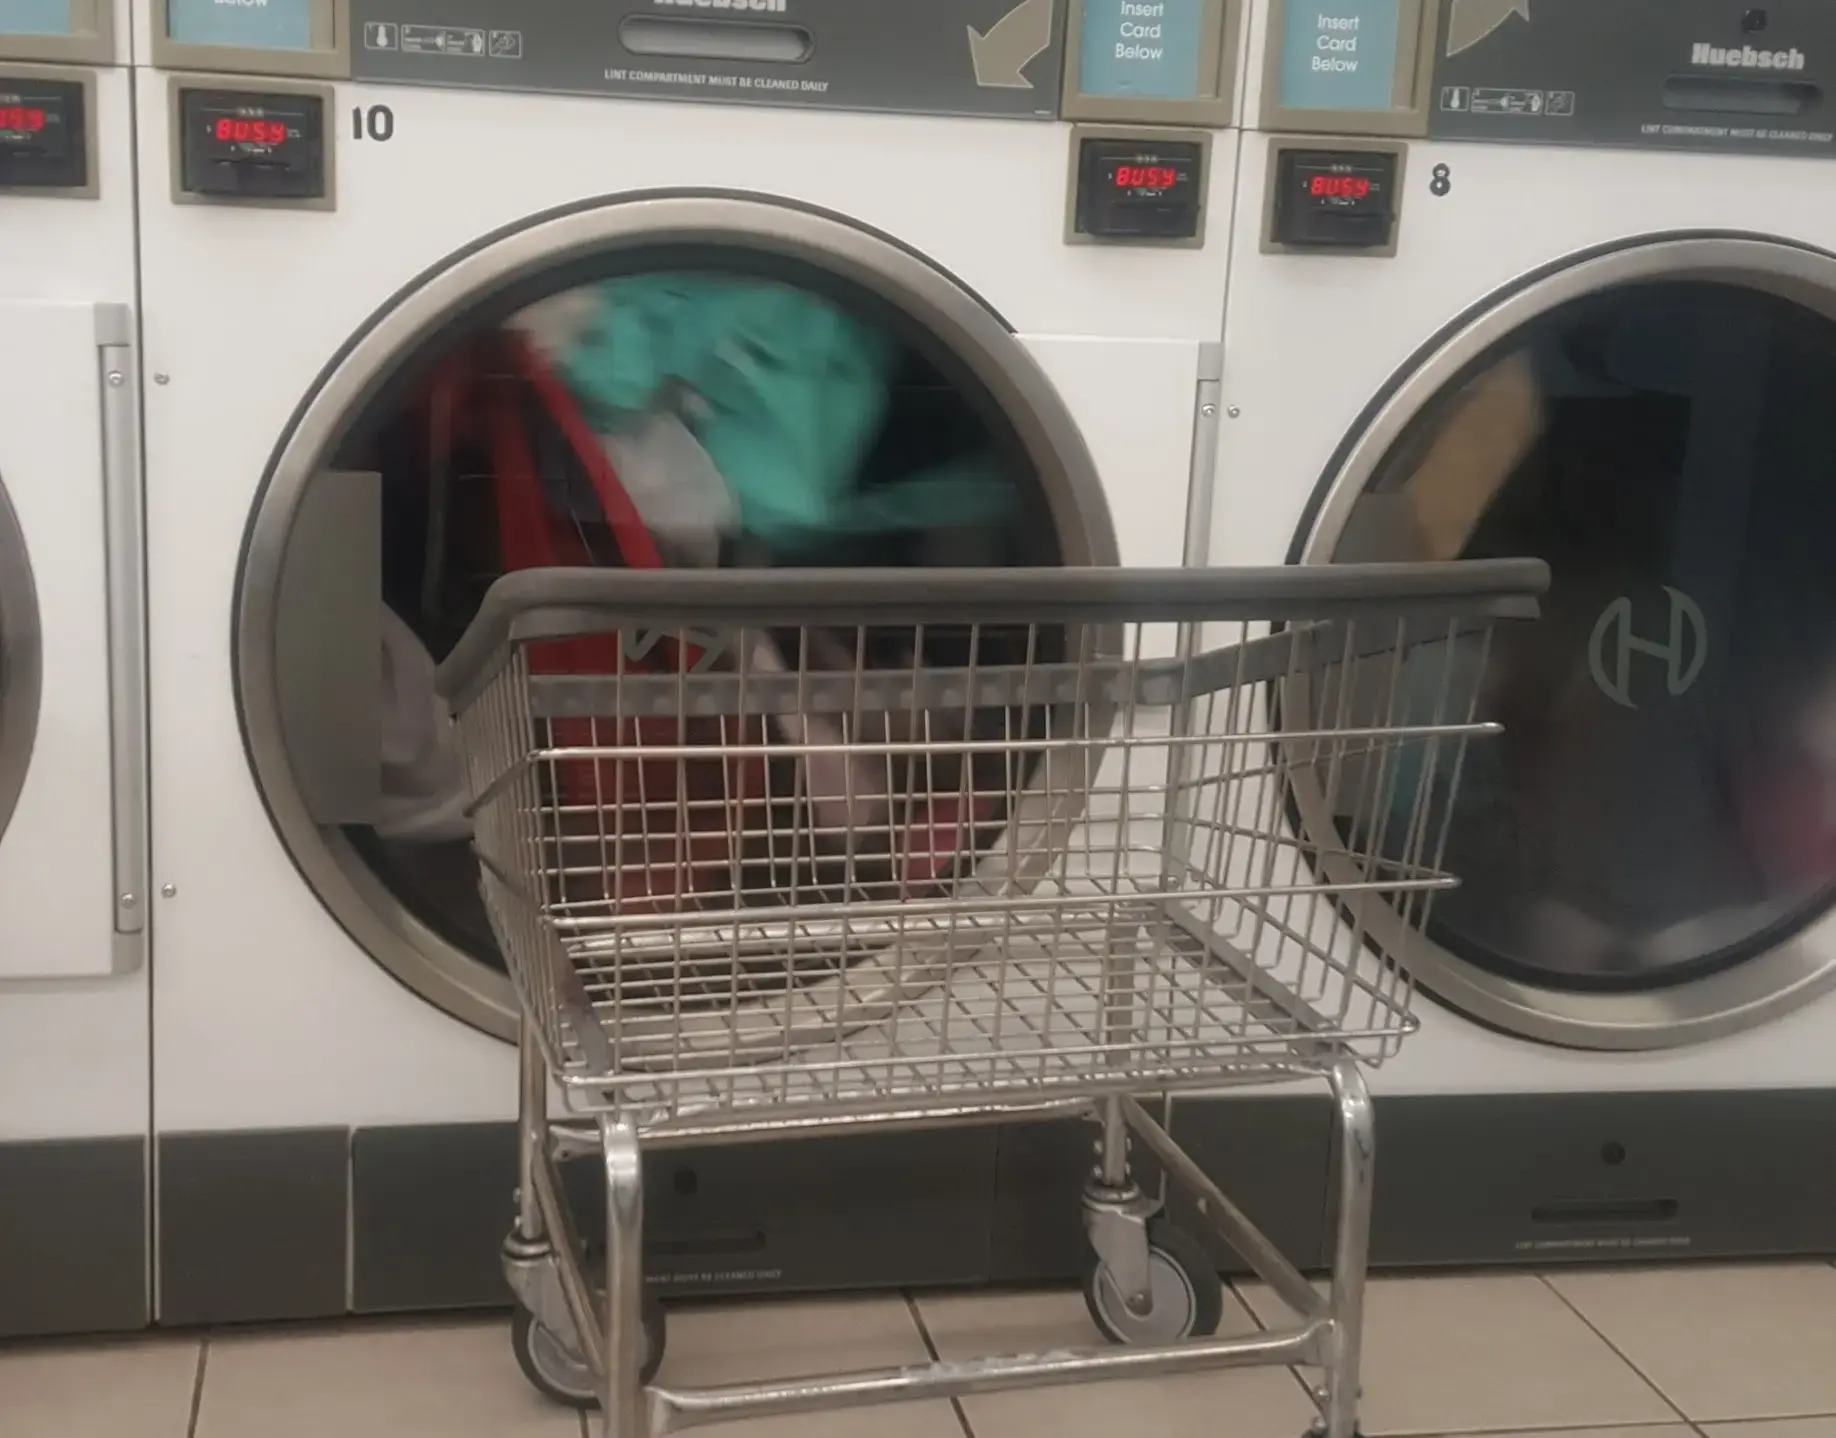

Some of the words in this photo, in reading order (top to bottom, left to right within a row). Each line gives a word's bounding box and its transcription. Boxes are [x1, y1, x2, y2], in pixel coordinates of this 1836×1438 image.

[1120, 1, 1164, 17] Insert
[1120, 22, 1161, 38] Card
[1317, 13, 1360, 30] Insert
[1115, 43, 1163, 60] Below
[1316, 35, 1358, 51] Card
[1311, 56, 1359, 72] Below
[1691, 42, 1805, 70] Huebsch
[604, 68, 626, 80] LINT
[629, 70, 706, 84] COMPARTMENT
[708, 75, 737, 87] MUST
[739, 77, 752, 88] BE
[754, 78, 799, 90] CLEANED
[800, 80, 829, 92] DAILY
[216, 118, 286, 144] BUSY
[352, 104, 394, 141] 10
[1115, 166, 1177, 188] BUSY
[1310, 175, 1371, 197] BUSY
[1429, 163, 1451, 197] 8
